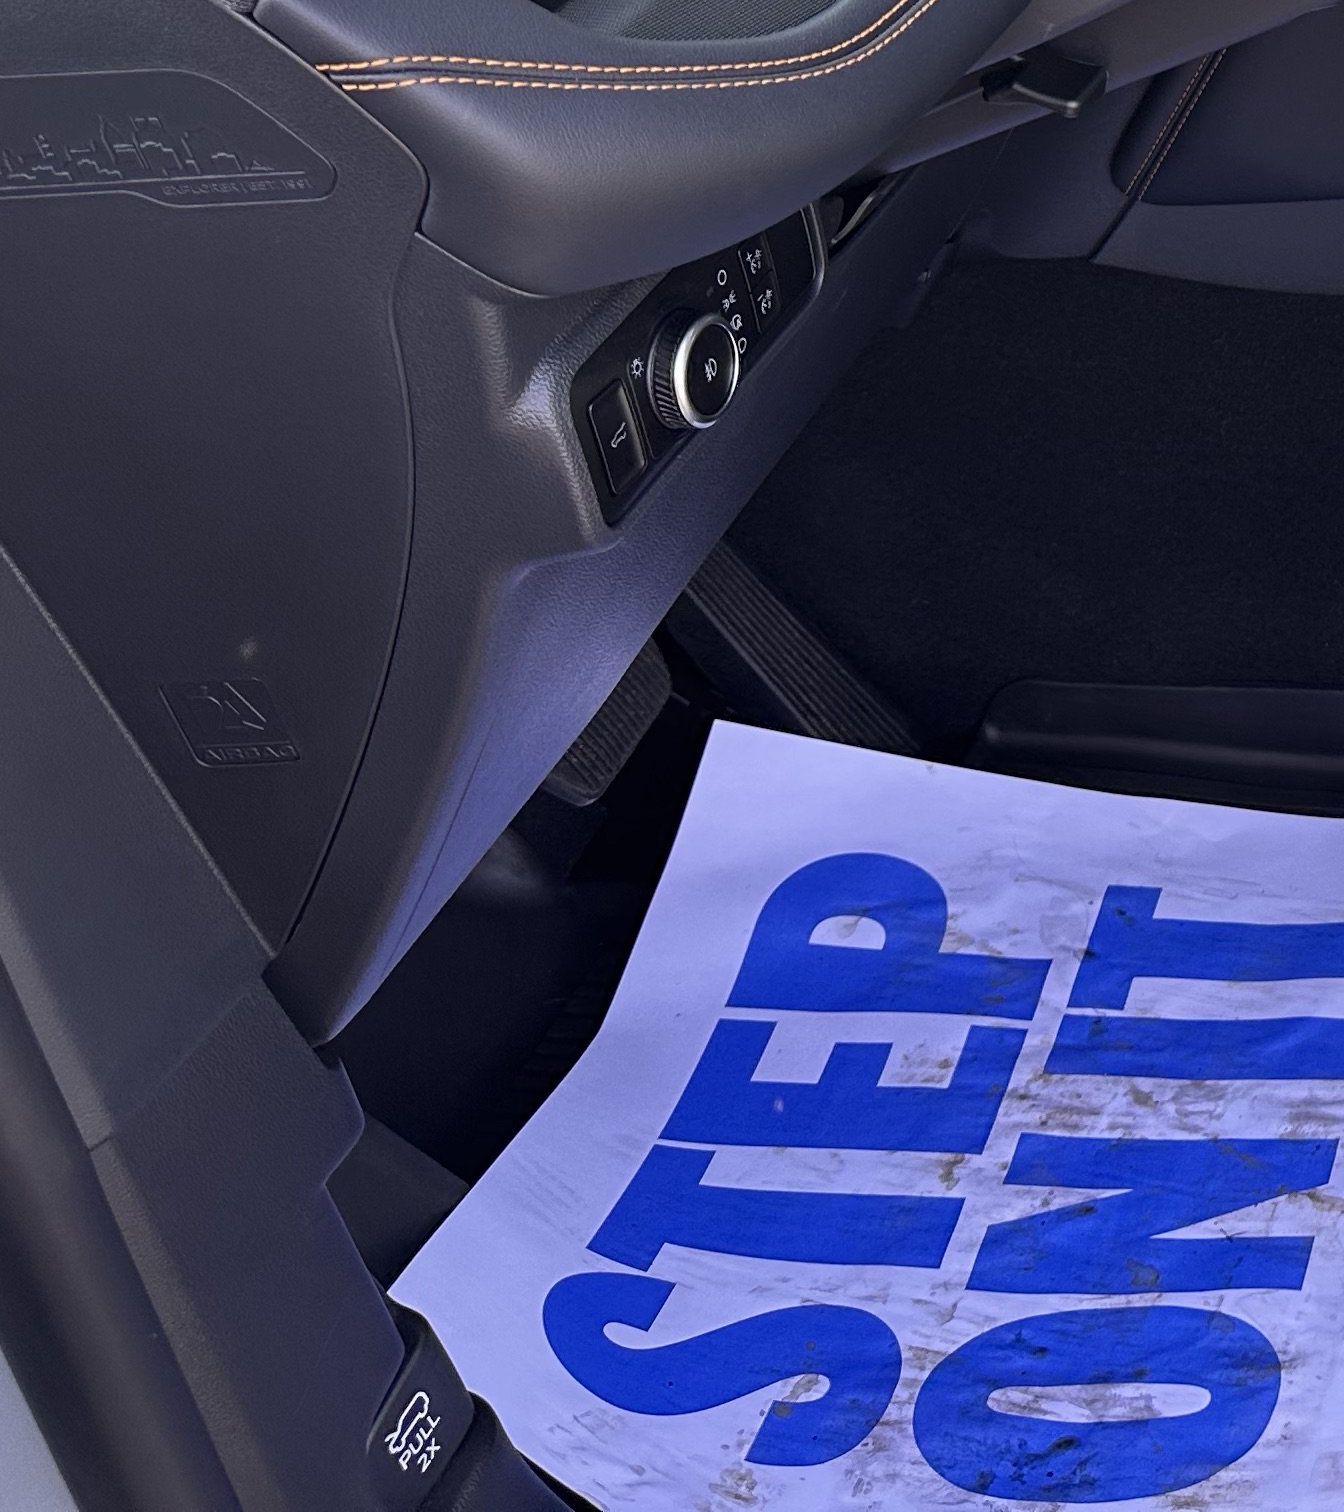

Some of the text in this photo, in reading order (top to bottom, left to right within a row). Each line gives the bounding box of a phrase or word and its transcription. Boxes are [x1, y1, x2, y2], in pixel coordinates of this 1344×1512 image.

[542, 852, 1052, 1467] STEP
[913, 1133, 1340, 1504] ON
[399, 1415, 441, 1471] PULL
[416, 1437, 441, 1473] 2X
